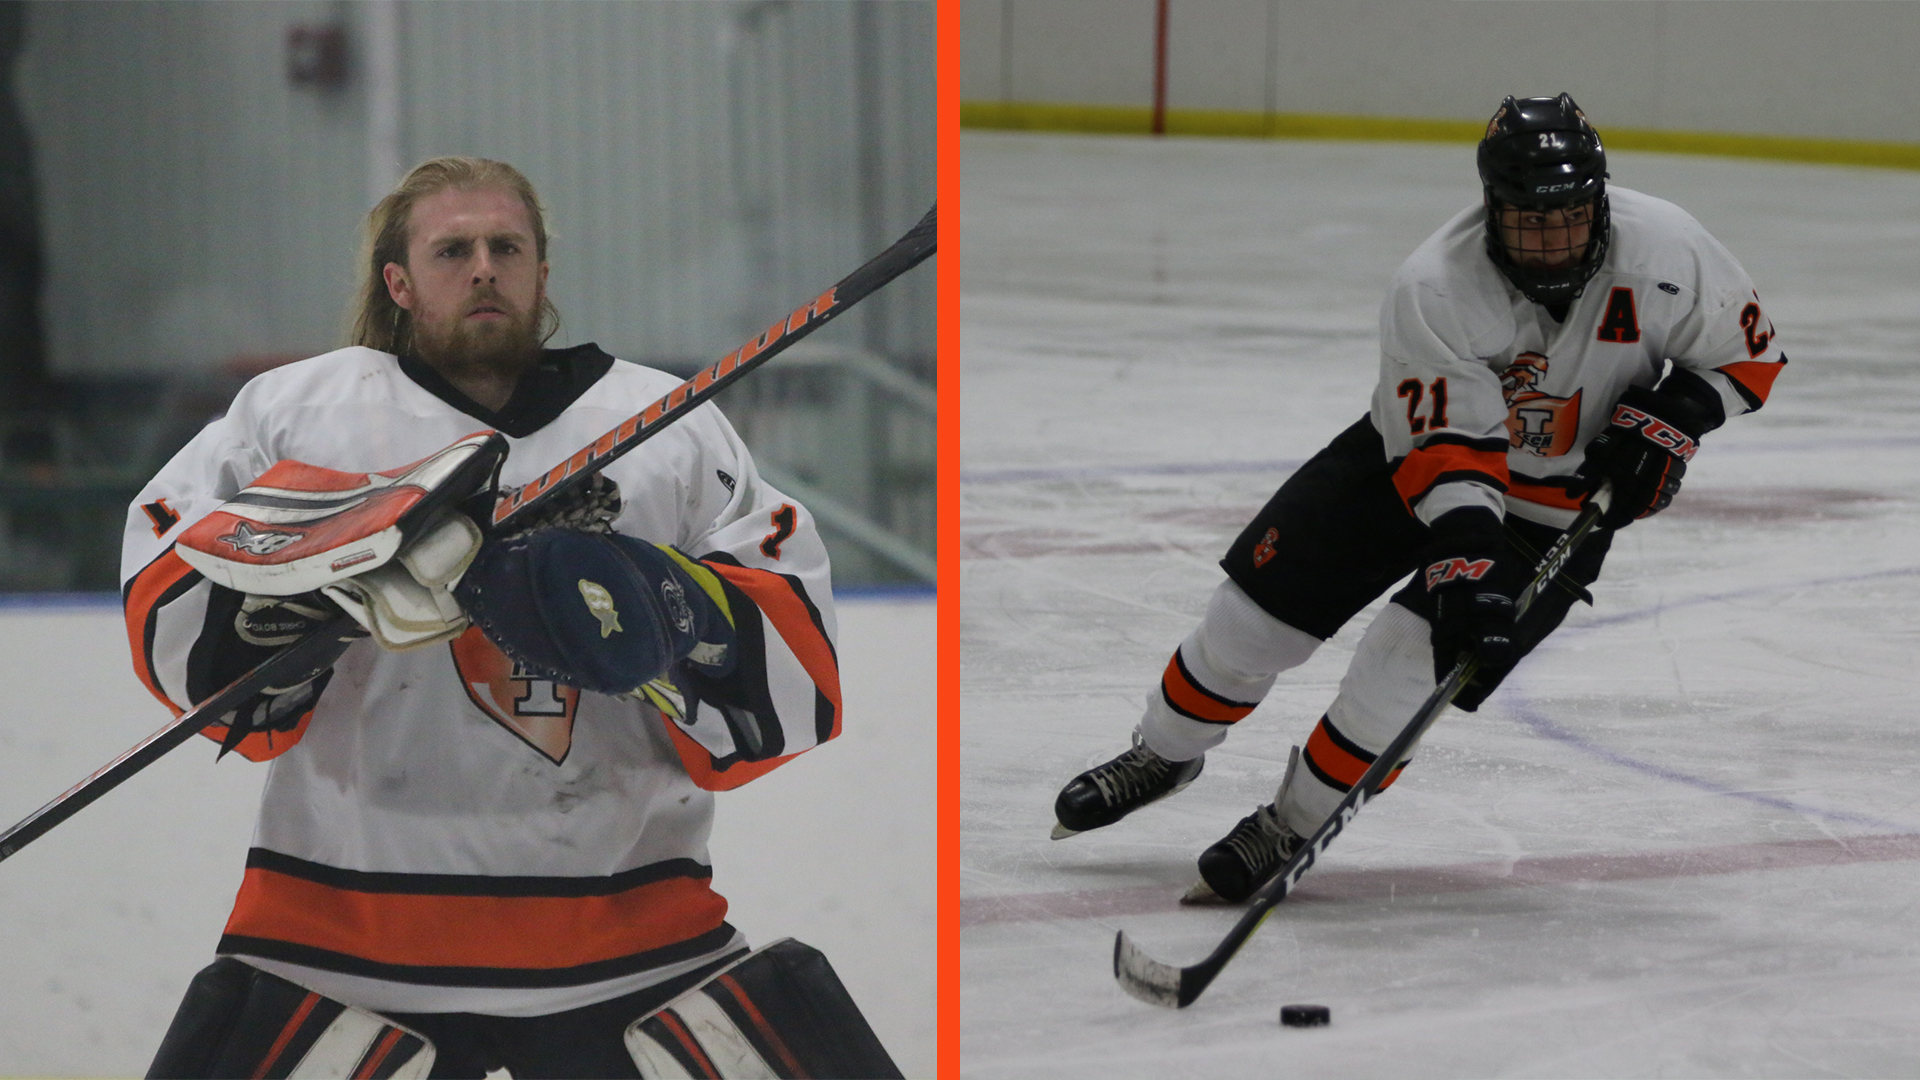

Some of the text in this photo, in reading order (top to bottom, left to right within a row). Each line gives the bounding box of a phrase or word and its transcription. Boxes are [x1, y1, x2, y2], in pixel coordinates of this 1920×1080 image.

[1539, 132, 1564, 148] 21
[1536, 182, 1575, 193] CCM
[1597, 286, 1641, 343] A
[491, 286, 839, 525] WARRIOR
[1397, 376, 1449, 436] 21
[1611, 403, 1699, 463] CCM
[139, 498, 182, 540] 1
[759, 503, 798, 561] 1
[1534, 533, 1569, 573] CCM
[1537, 545, 1571, 593] CCM
[252, 623, 277, 632] BOYD
[1483, 635, 1510, 643] CCM
[1284, 787, 1365, 895] CCM
